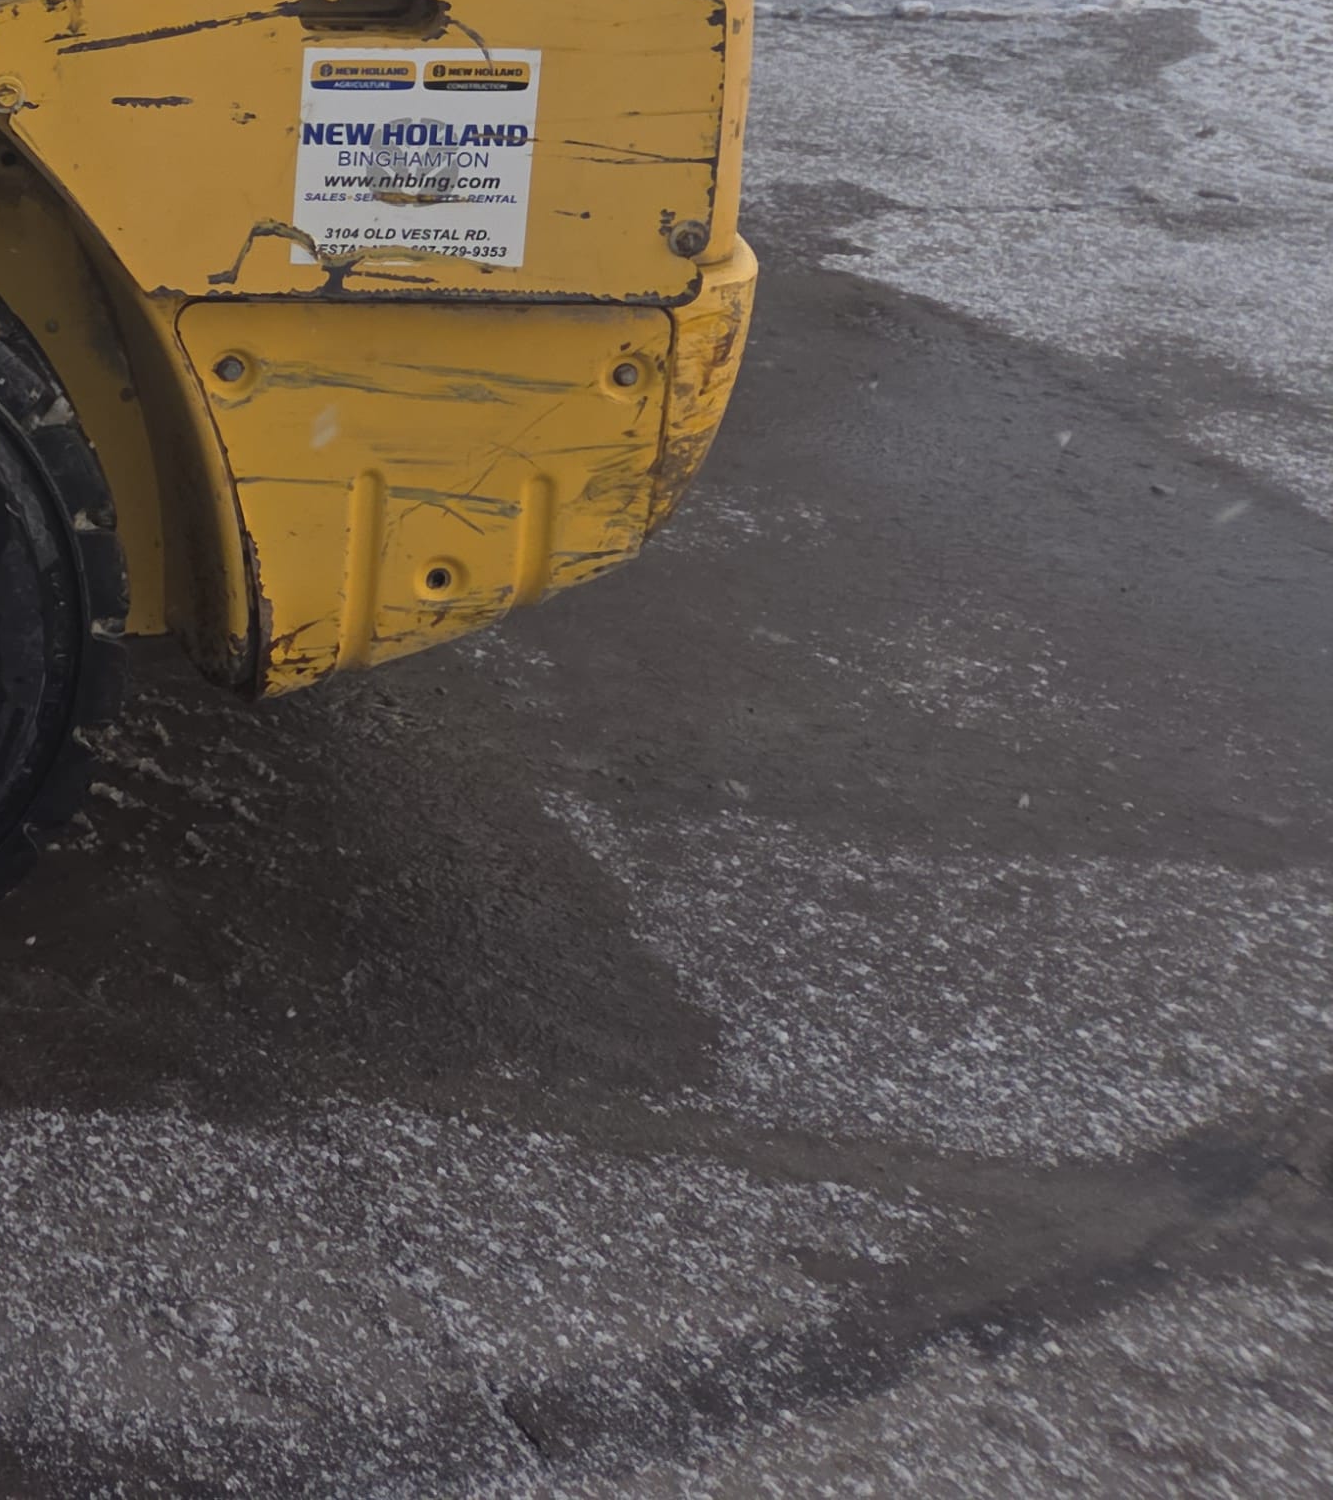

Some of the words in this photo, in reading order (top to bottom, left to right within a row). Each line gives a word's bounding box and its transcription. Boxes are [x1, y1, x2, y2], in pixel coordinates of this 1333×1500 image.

[335, 67, 359, 76] NEW
[361, 67, 409, 76] HOLLAND
[448, 68, 473, 77] NEW
[474, 68, 523, 77] HOLLAND
[333, 81, 392, 89] AGRICULTURE
[446, 82, 508, 91] CONSTRUCTION
[302, 123, 375, 146] NEW
[383, 123, 529, 147] HOLLAND
[337, 151, 489, 168] BINGHAMTON
[324, 173, 500, 192] www.nhbing.com
[304, 192, 347, 202] SALES
[467, 194, 518, 204] RENTAL
[324, 228, 359, 239] 3104
[364, 228, 396, 240] OLD
[401, 229, 459, 241] VESTAL
[464, 230, 491, 241] RD.
